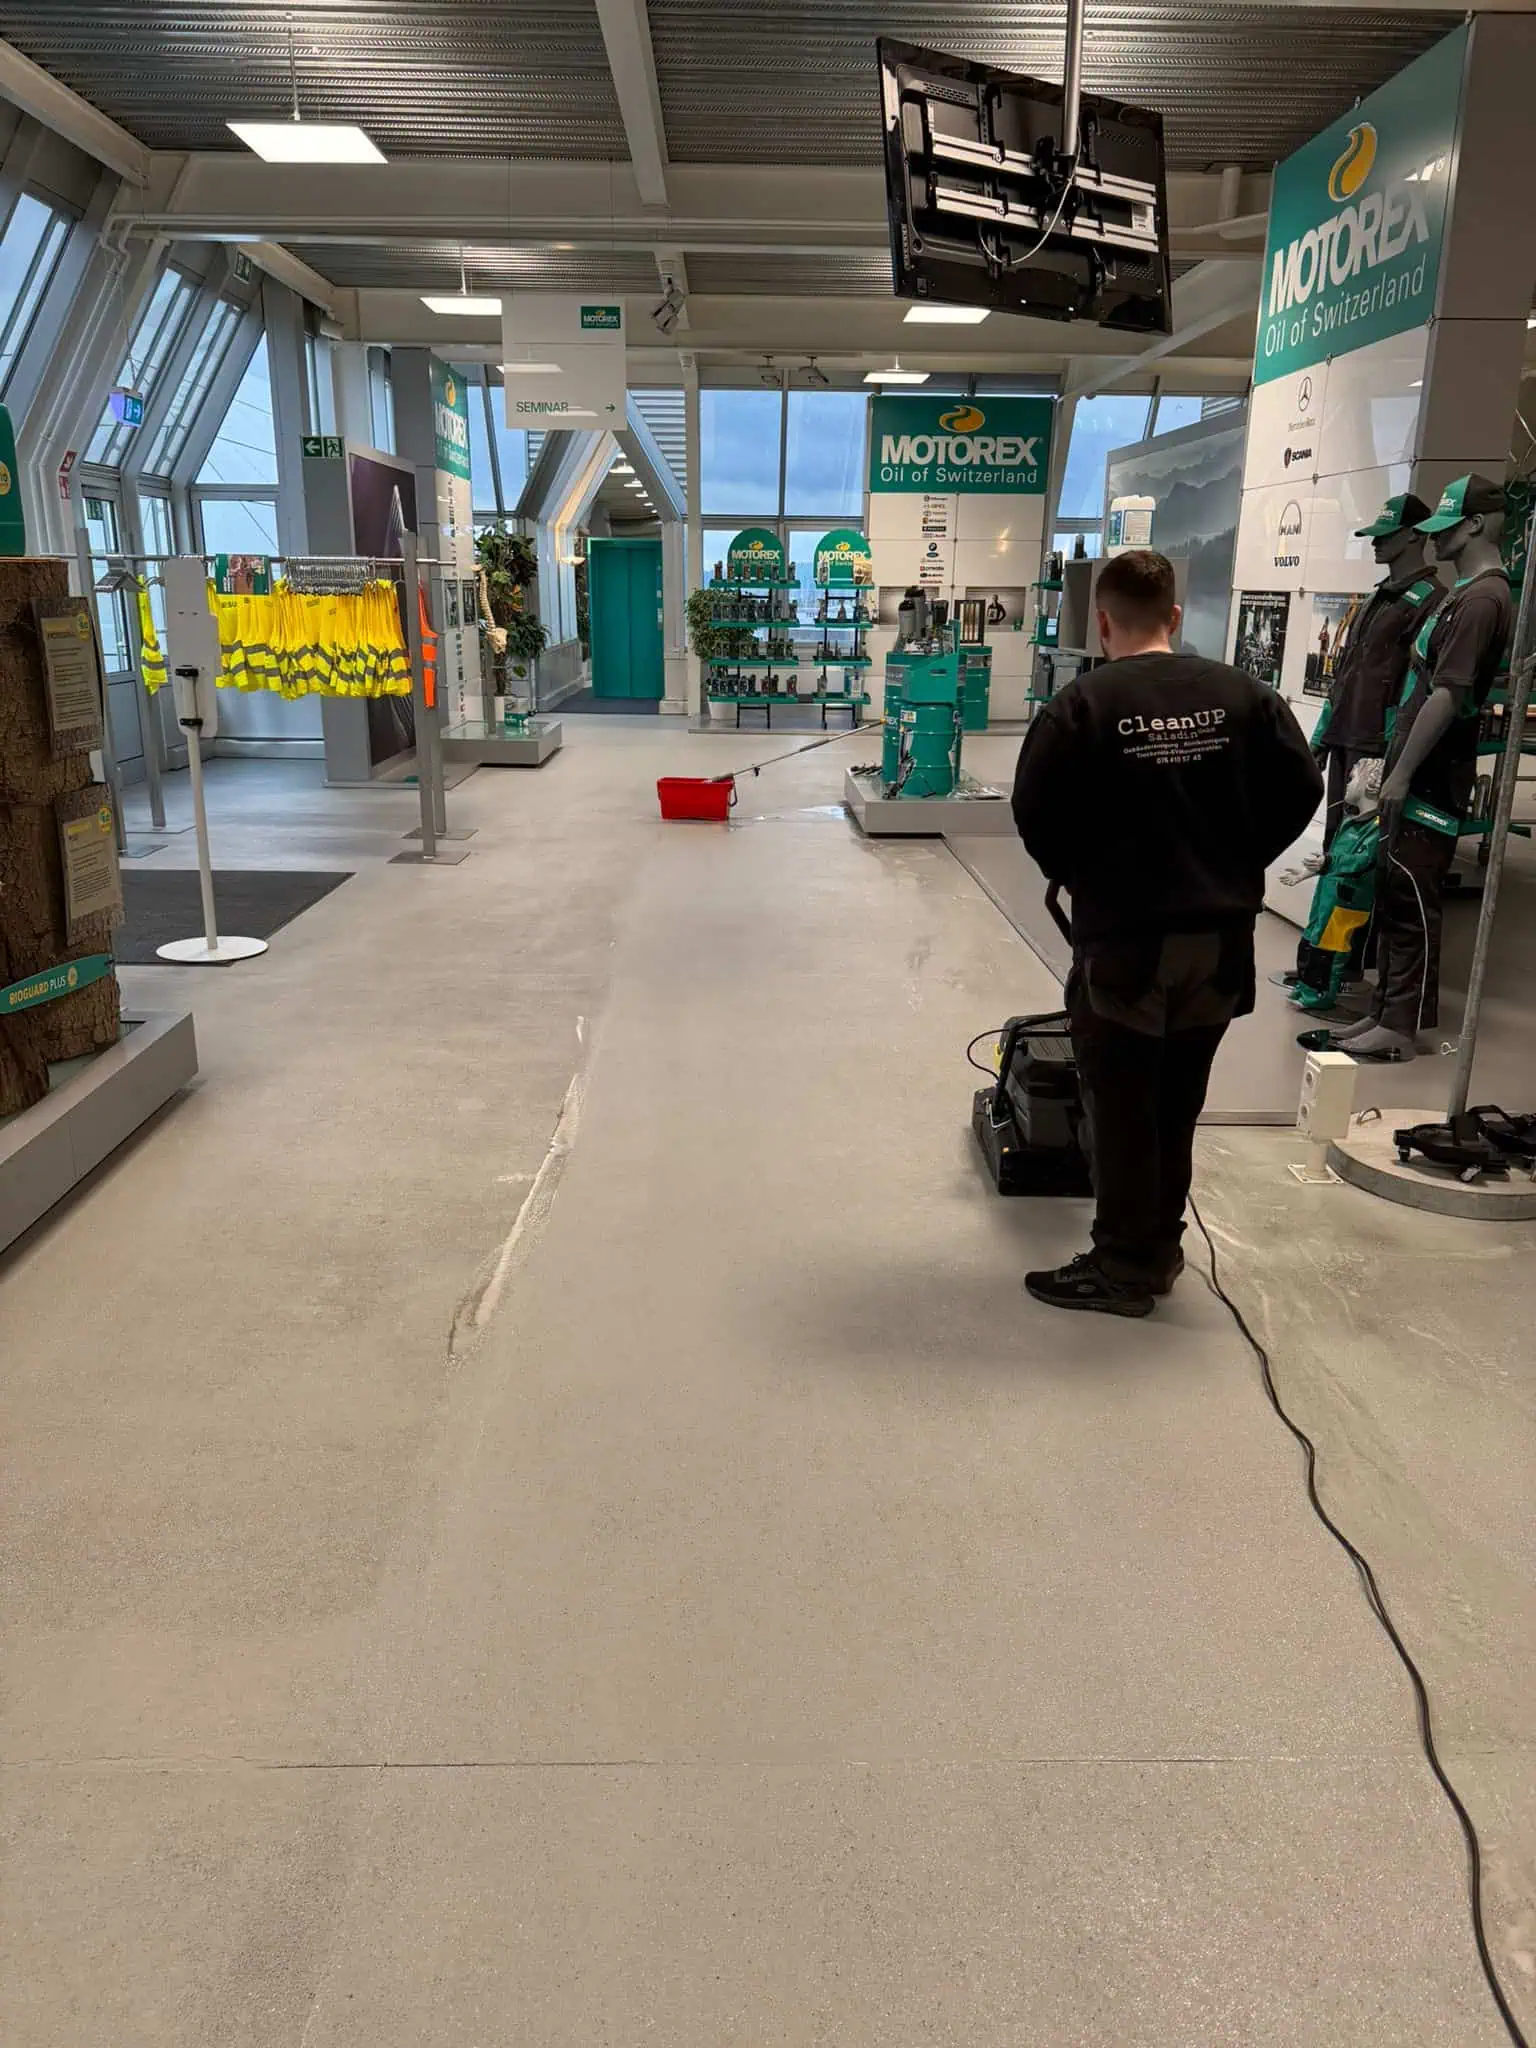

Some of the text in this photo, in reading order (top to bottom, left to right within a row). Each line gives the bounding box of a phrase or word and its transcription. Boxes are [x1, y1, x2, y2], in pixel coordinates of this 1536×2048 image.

[1268, 163, 1435, 317] MOTOREX
[1265, 252, 1426, 357] Oil of Switzerland
[516, 401, 569, 413] SEMINAR
[881, 435, 1038, 466] MOTOREX
[1291, 448, 1312, 462] SCANIA
[880, 467, 1037, 484] Oil of Switzerland
[1280, 523, 1301, 535] MAN
[732, 550, 780, 560] MOTOREX
[818, 551, 867, 561] MOTOREX
[1274, 555, 1300, 567] VOLVO
[1118, 708, 1226, 735] CleanUP
[1148, 731, 1198, 742] Saladin
[9, 975, 66, 1005] BIOGUARD PLUS
